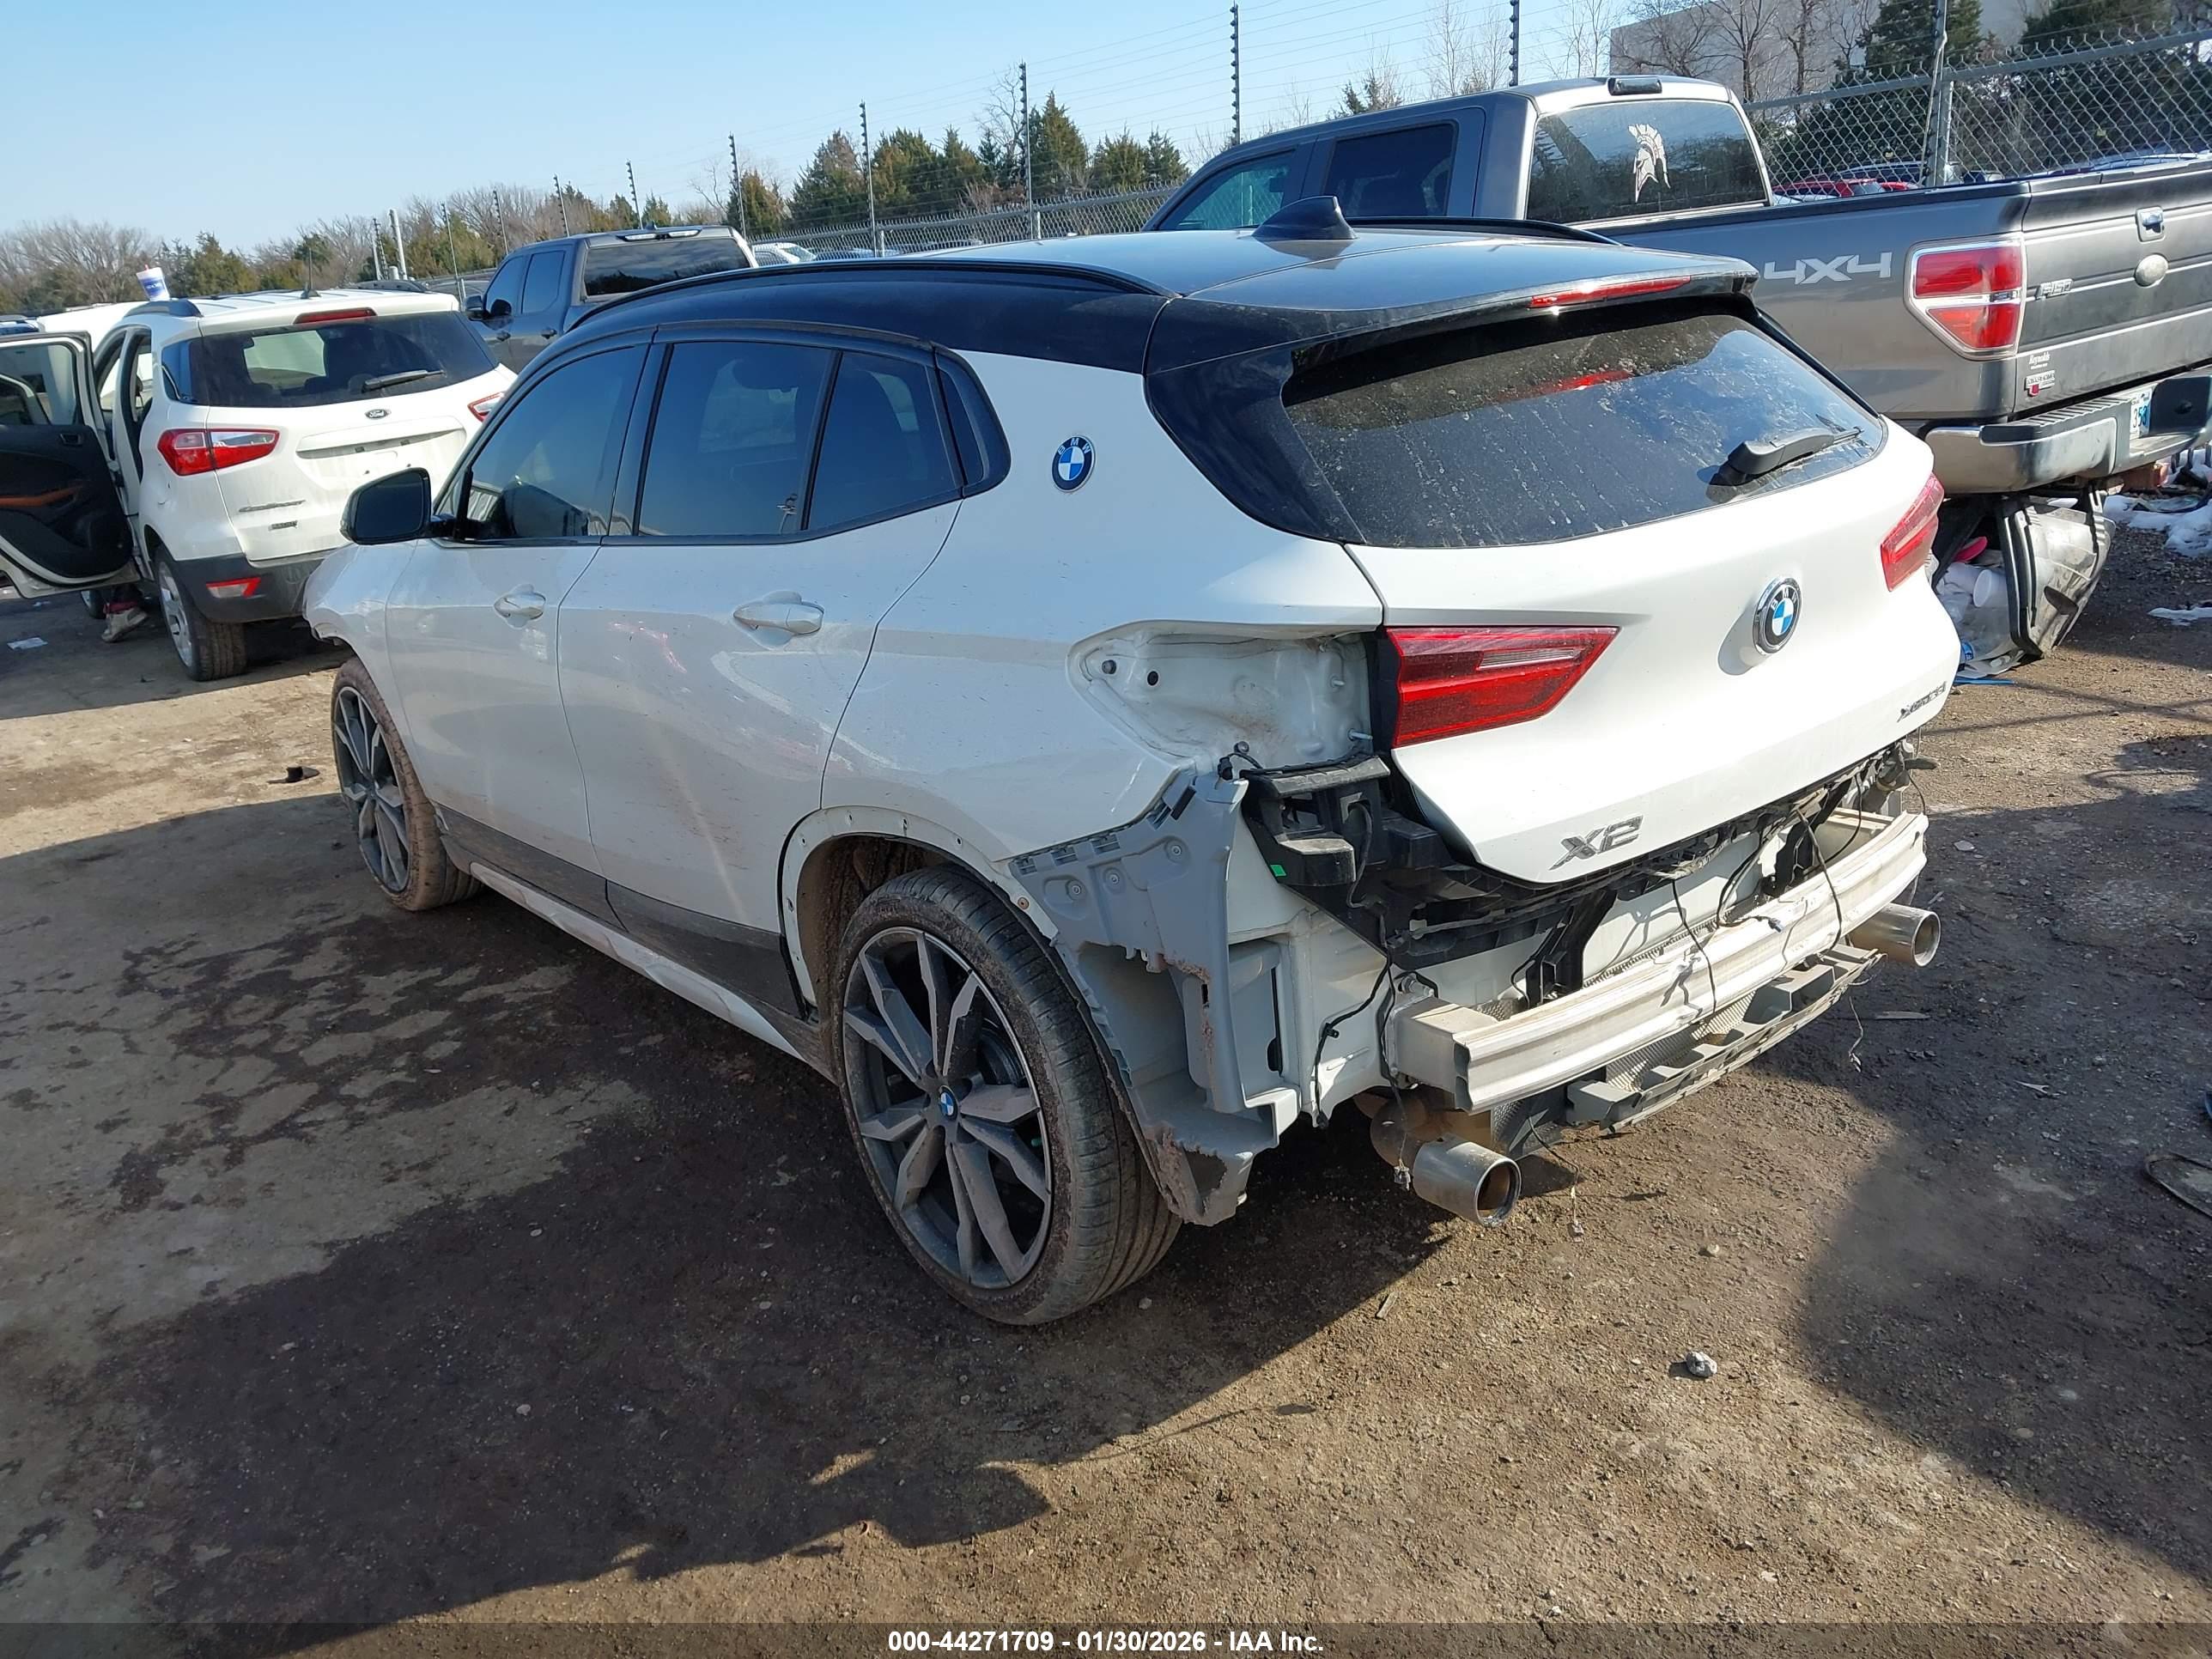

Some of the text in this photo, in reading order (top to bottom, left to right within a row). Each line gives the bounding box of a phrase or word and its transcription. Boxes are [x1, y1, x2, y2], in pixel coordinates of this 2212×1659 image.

[1763, 252, 1893, 285] 4X4
[1057, 437, 1091, 455] BMW
[1771, 586, 1798, 611] BMW
[1548, 815, 1644, 871] X2
